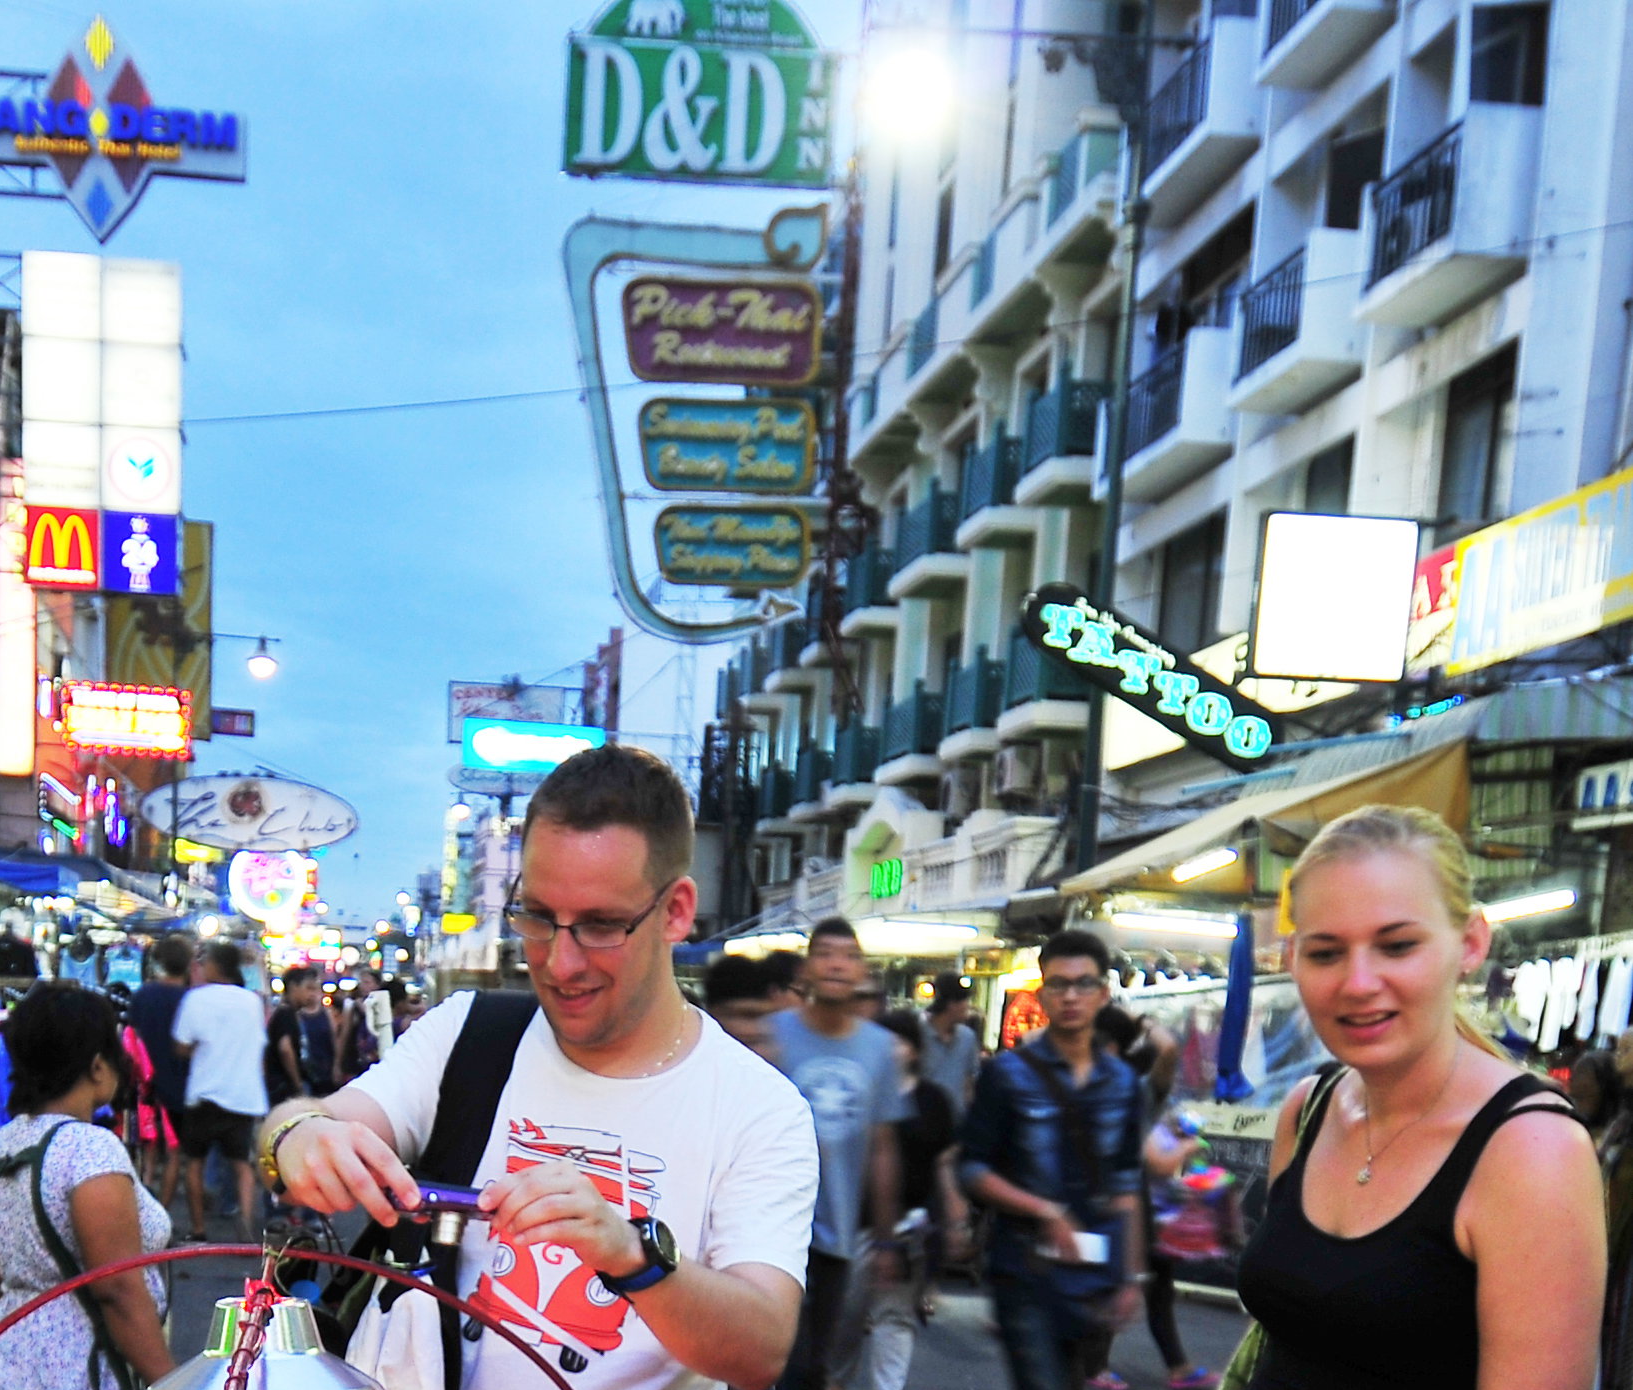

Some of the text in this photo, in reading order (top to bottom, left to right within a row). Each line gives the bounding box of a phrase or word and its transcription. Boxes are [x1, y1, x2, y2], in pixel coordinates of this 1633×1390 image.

[109, 104, 238, 149] DERM
[572, 41, 786, 173] D&D
[795, 58, 827, 171] INN
[137, 142, 181, 160] Hotel
[631, 283, 812, 333] Pick-Thai
[1039, 602, 1273, 759] TATTOO
[258, 805, 345, 836] Club
